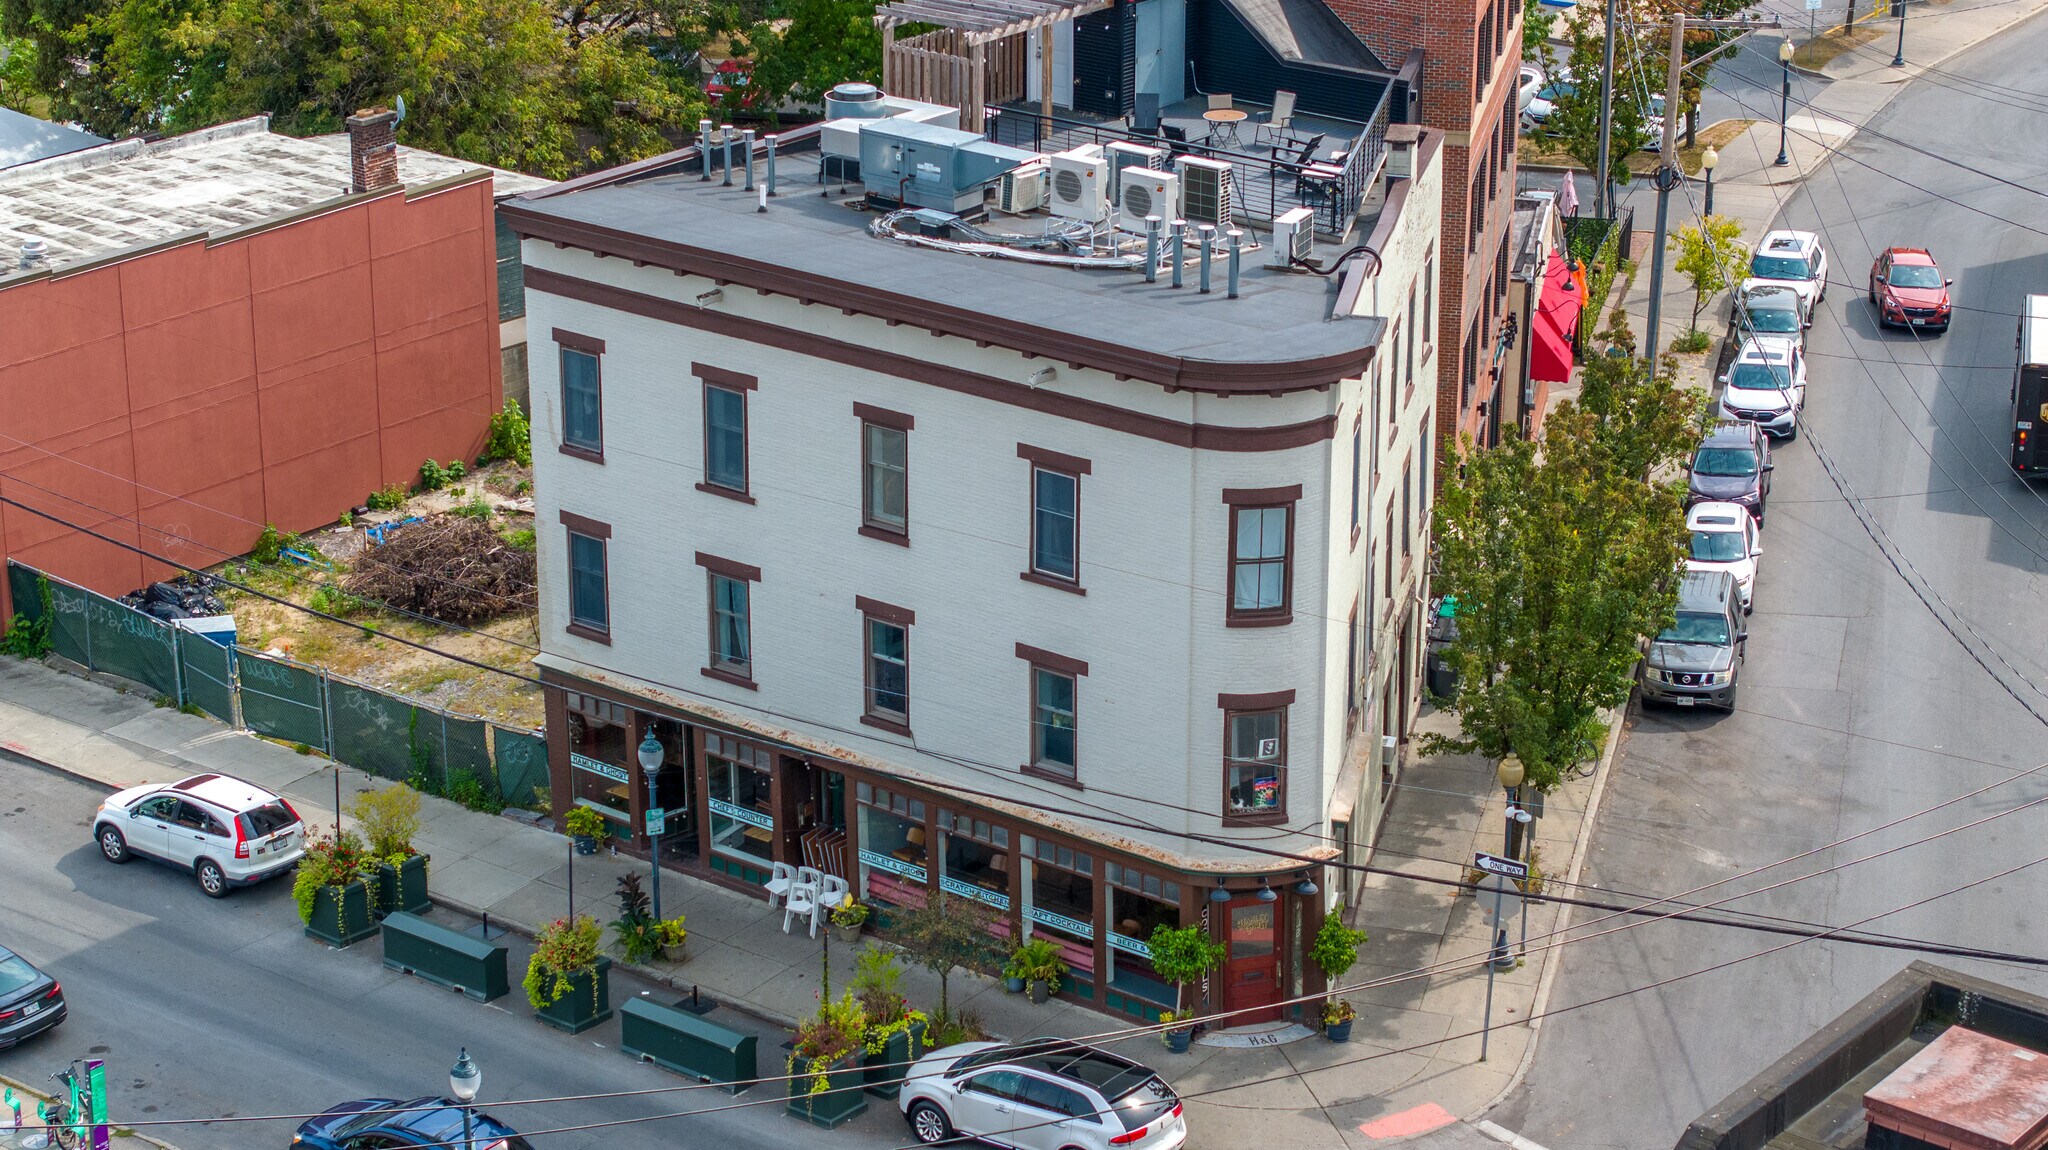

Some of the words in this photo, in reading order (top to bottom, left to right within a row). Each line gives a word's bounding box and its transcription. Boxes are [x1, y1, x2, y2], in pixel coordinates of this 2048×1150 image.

[573, 755, 598, 770] HAMLET
[605, 766, 627, 779] GHOST
[737, 808, 768, 825] COUNTER
[860, 851, 890, 866] HAMLET
[1489, 861, 1505, 871] ONE
[1506, 865, 1522, 875] WAY
[940, 879, 975, 894] SCRATCH
[1023, 907, 1048, 920] CRAFT
[1050, 915, 1093, 935] COCKTAILS
[1116, 937, 1138, 949] BEER
[1248, 1034, 1278, 1046] H&G
